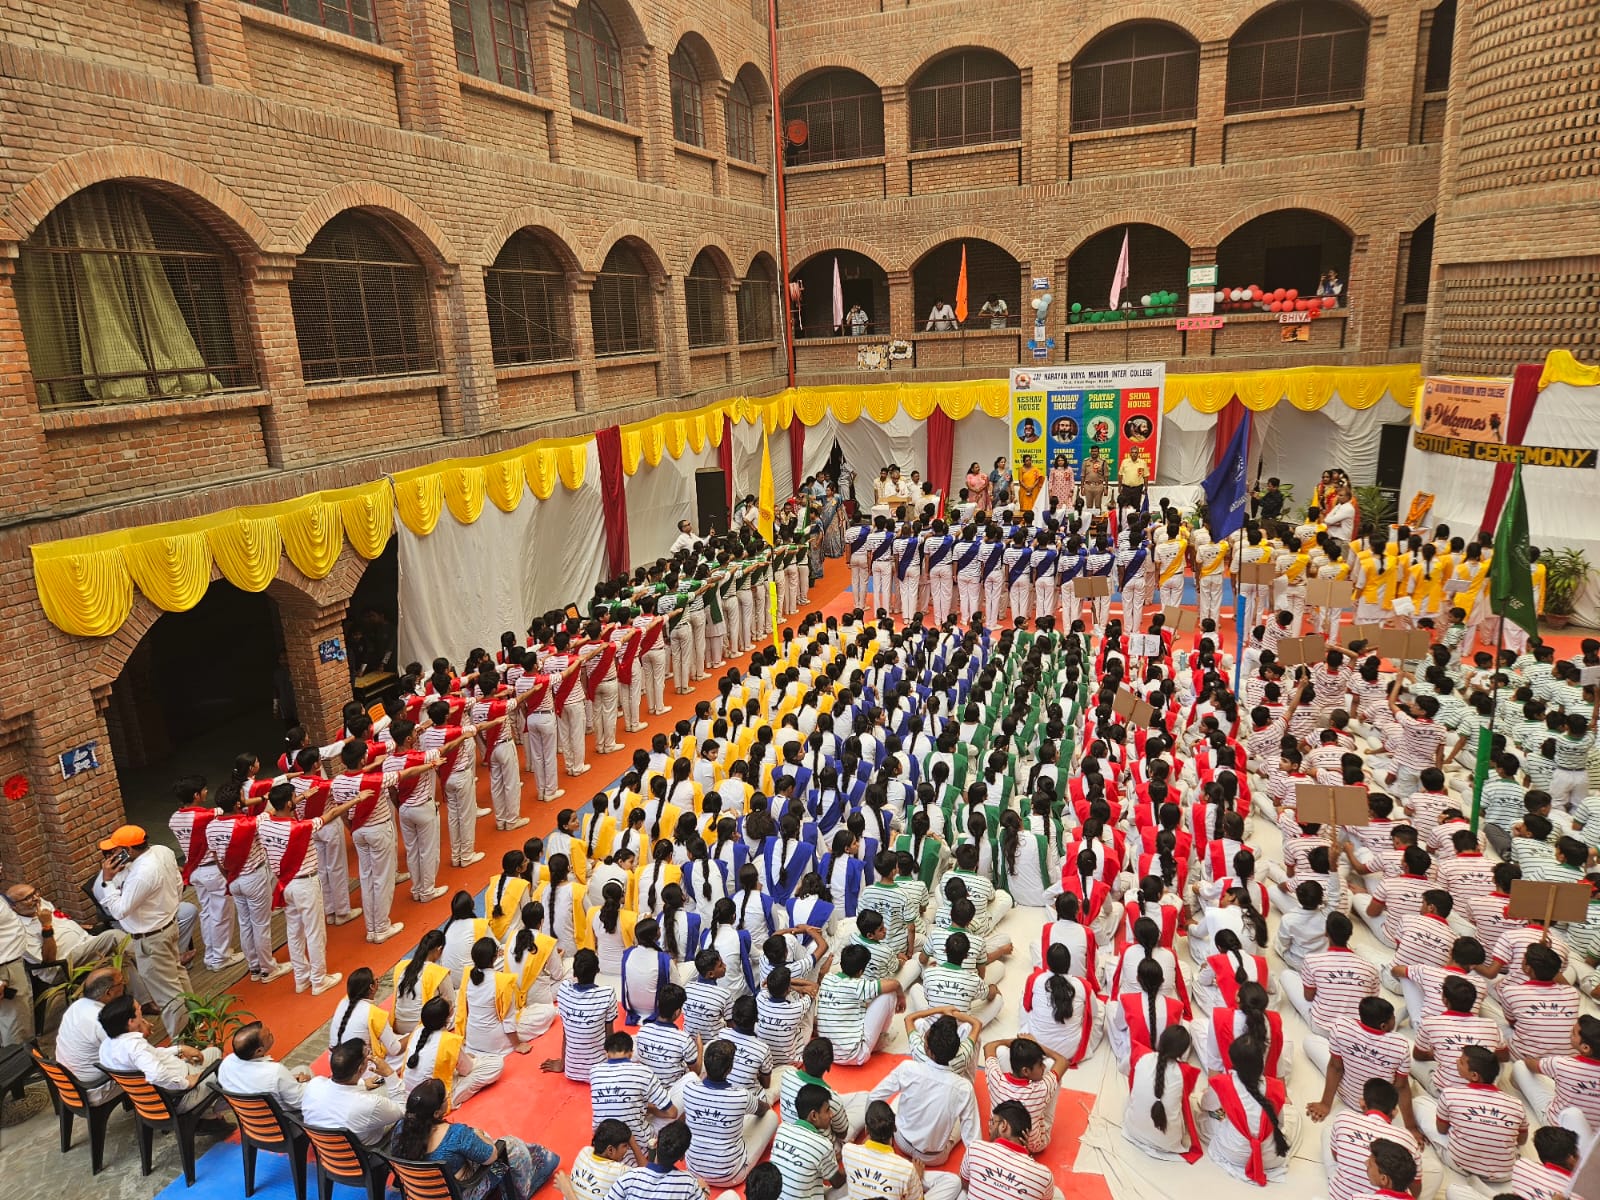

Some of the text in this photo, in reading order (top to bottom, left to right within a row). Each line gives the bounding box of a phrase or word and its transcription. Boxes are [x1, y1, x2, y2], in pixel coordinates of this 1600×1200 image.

[1179, 319, 1220, 329] PRATAP
[1111, 369, 1127, 378] INTER
[1129, 368, 1153, 378] COLLEGE
[1050, 394, 1080, 402] MADHAV
[1088, 393, 1115, 401] PRATAP
[1128, 392, 1151, 401] SHIVA
[1018, 403, 1040, 411] HOUSE
[1053, 402, 1077, 410] HOUSE
[1090, 401, 1114, 409] HOUSE
[1127, 400, 1151, 408] HOUSE
[1434, 402, 1487, 431] Welcomes
[1474, 443, 1591, 468] CEREMONY
[1463, 1104, 1514, 1127] JNVMIC
